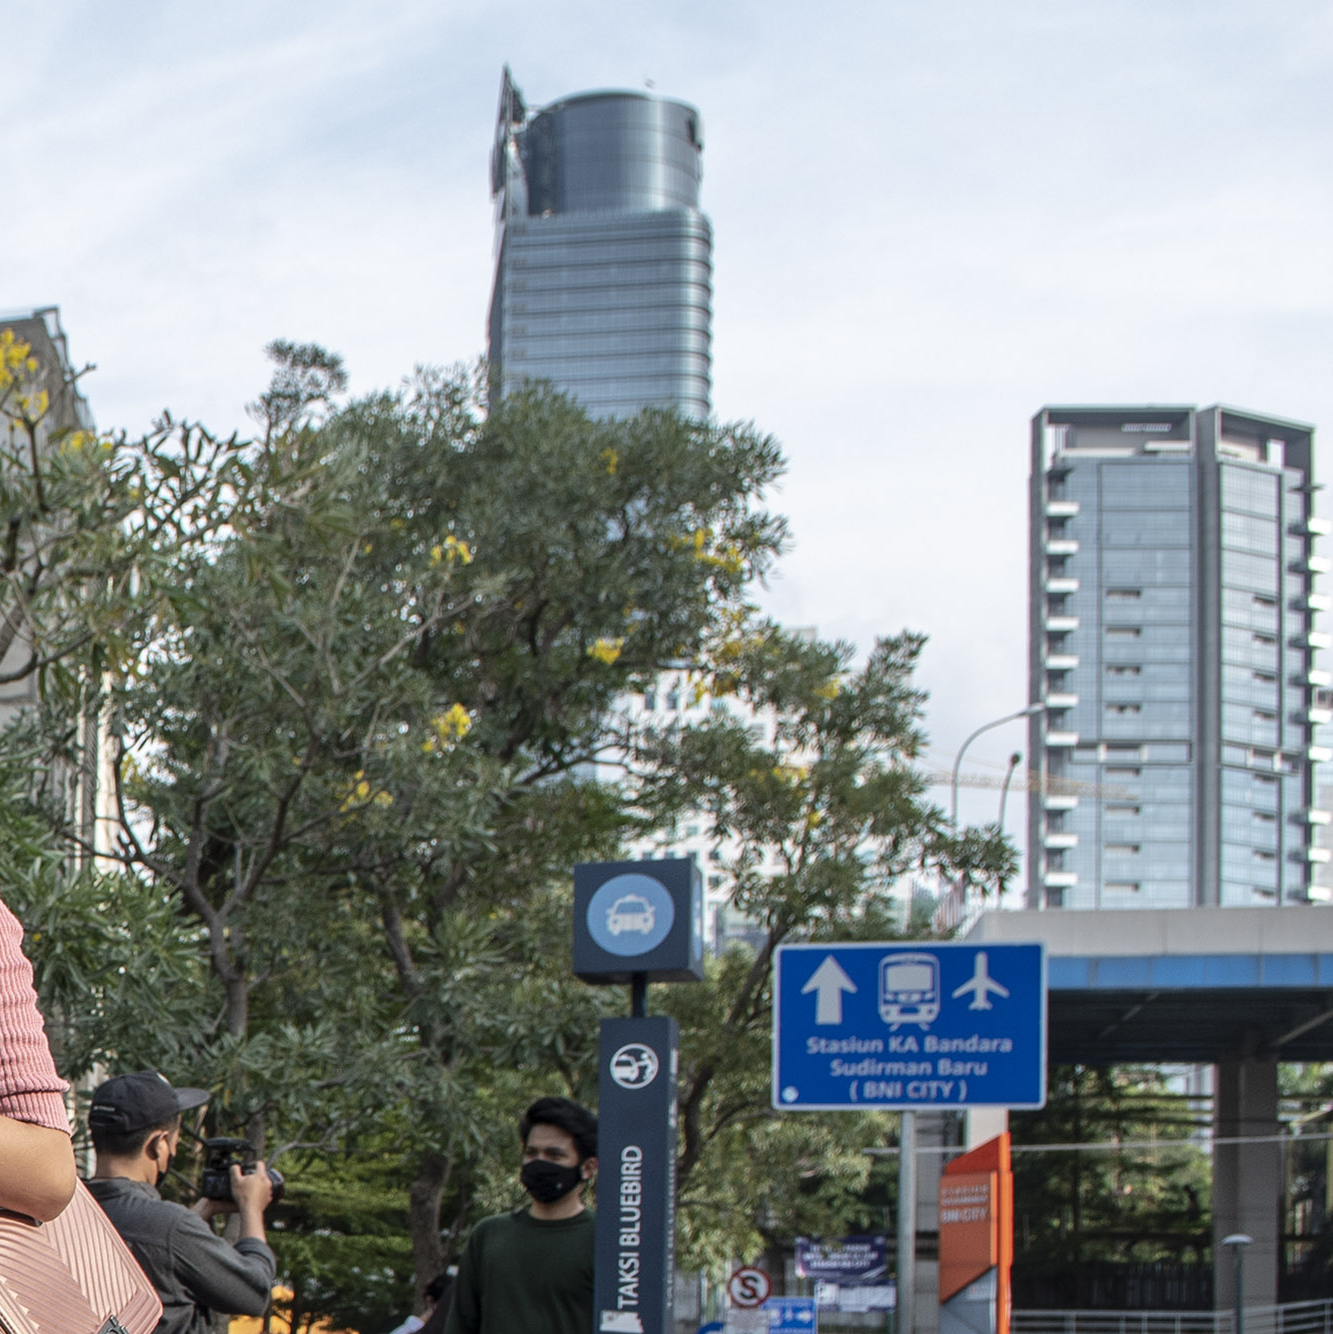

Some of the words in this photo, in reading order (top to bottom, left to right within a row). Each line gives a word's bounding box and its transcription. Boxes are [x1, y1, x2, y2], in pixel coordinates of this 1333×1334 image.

[806, 1035, 883, 1054] Stasiun
[888, 1036, 919, 1053] KA
[924, 1034, 1013, 1053] Bandara
[829, 1058, 932, 1077] Sudirman
[937, 1059, 988, 1076] Baru
[863, 1081, 902, 1099] BNI
[906, 1081, 955, 1099] CITY
[619, 1145, 644, 1246] BLUEBIRD
[616, 1251, 641, 1309] TAKSI
